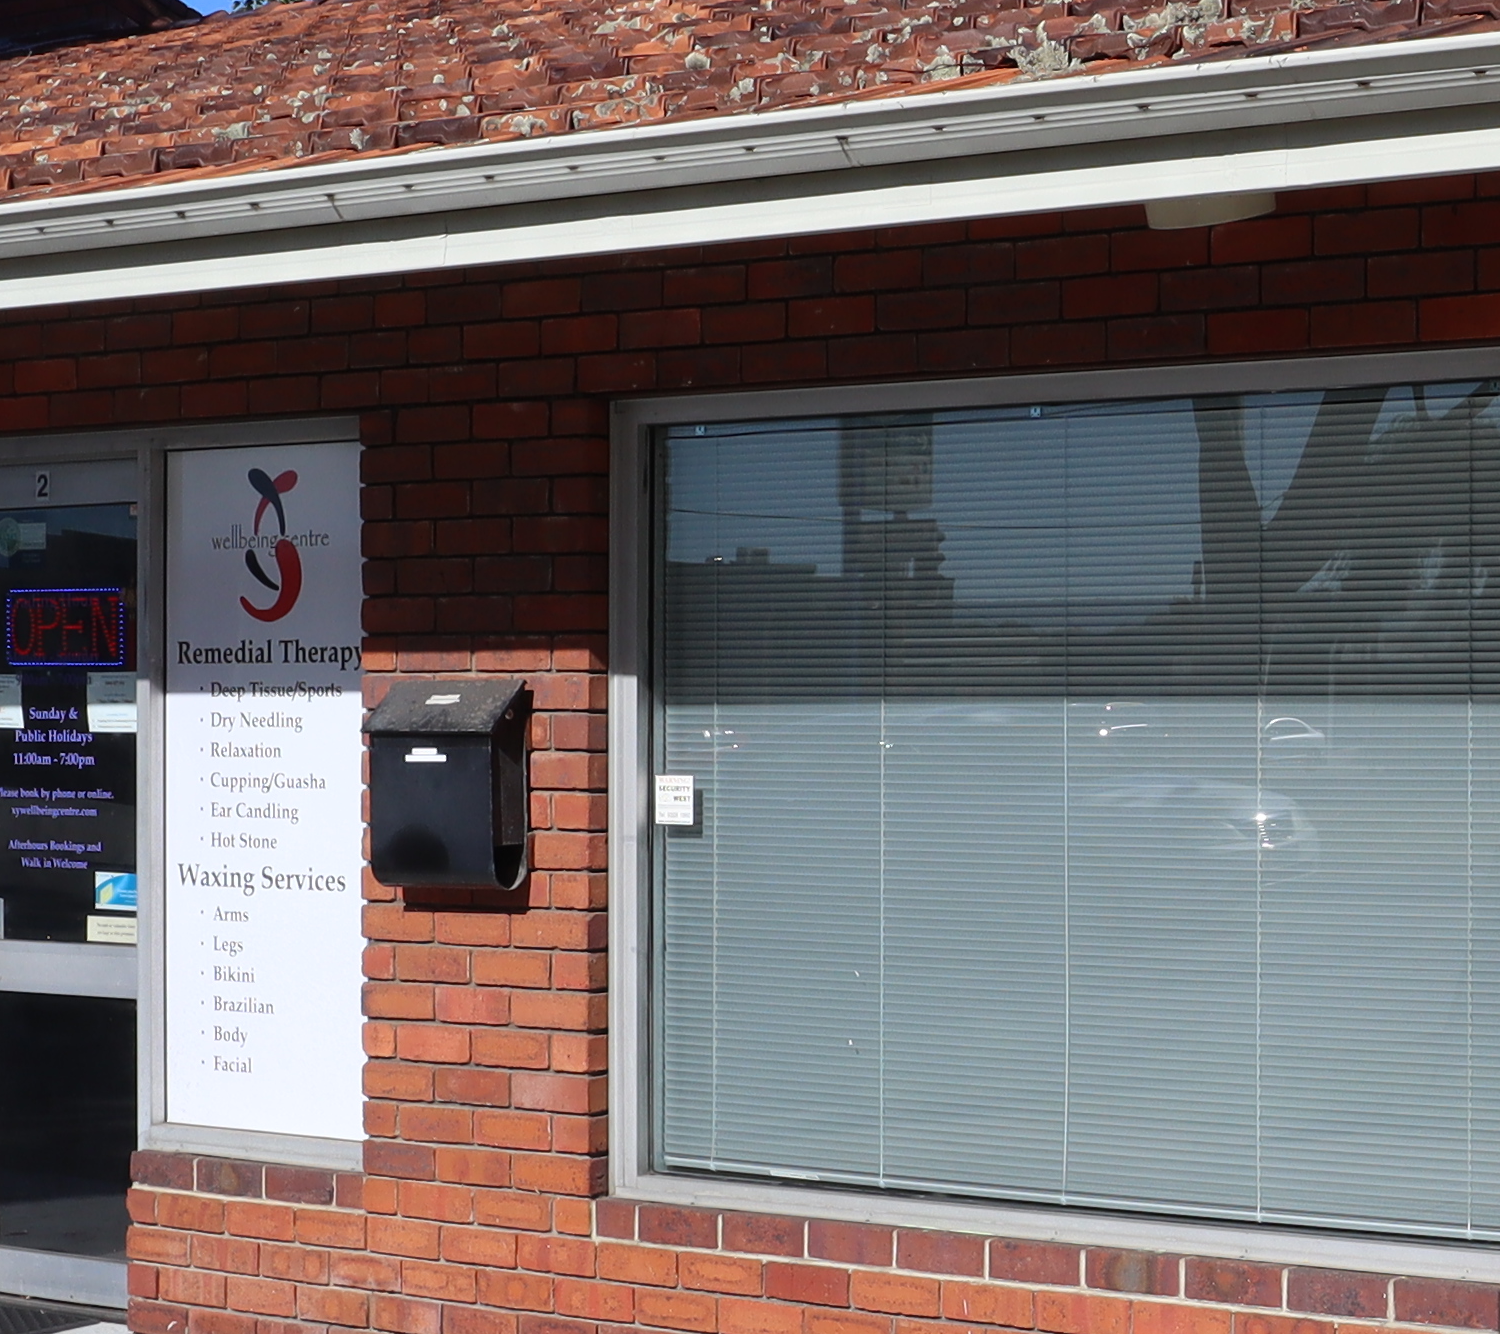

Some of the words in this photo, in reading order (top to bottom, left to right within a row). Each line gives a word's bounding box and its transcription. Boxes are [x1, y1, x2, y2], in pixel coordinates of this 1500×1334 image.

[37, 474, 48, 498] 2
[212, 524, 278, 557] wellbeing
[284, 530, 329, 548] entre
[11, 596, 120, 658] OPEN
[177, 639, 273, 665] Remedial
[279, 640, 362, 671] Therapy
[210, 681, 245, 702] Deep
[250, 681, 342, 702] Tissue/Sports
[29, 706, 66, 723] Sunday
[68, 707, 78, 720] &
[210, 712, 236, 732] Dry
[240, 712, 303, 733] Needling
[15, 729, 46, 743] Public
[48, 730, 93, 746] Holidays
[210, 742, 282, 758] Relaxation
[13, 752, 51, 766] 11:00am
[60, 753, 95, 769] 7:00pm
[210, 771, 326, 794] Cupping/Guasha
[20, 787, 39, 799] book
[41, 788, 51, 801] by
[52, 788, 76, 801] phone
[77, 791, 86, 799] or
[87, 788, 114, 800] online.
[11, 805, 97, 818] xywellbeingcentre.com
[210, 802, 232, 818] Ear
[236, 803, 299, 825] Candling
[8, 839, 48, 851] Afterhours
[49, 840, 85, 854] Bookings
[86, 842, 101, 853] and
[211, 832, 235, 848] Hot
[239, 832, 277, 849] Stone
[21, 857, 41, 868] Walk
[43, 858, 52, 868] in
[53, 858, 88, 870] Welcome
[178, 863, 255, 896] Waxing
[261, 866, 346, 892] Services
[213, 906, 249, 922] Arms
[213, 936, 244, 957] Legs
[213, 966, 255, 983] Bikini
[213, 996, 274, 1014] Brazilian
[213, 1025, 248, 1048] Body
[213, 1056, 252, 1073] Facial
